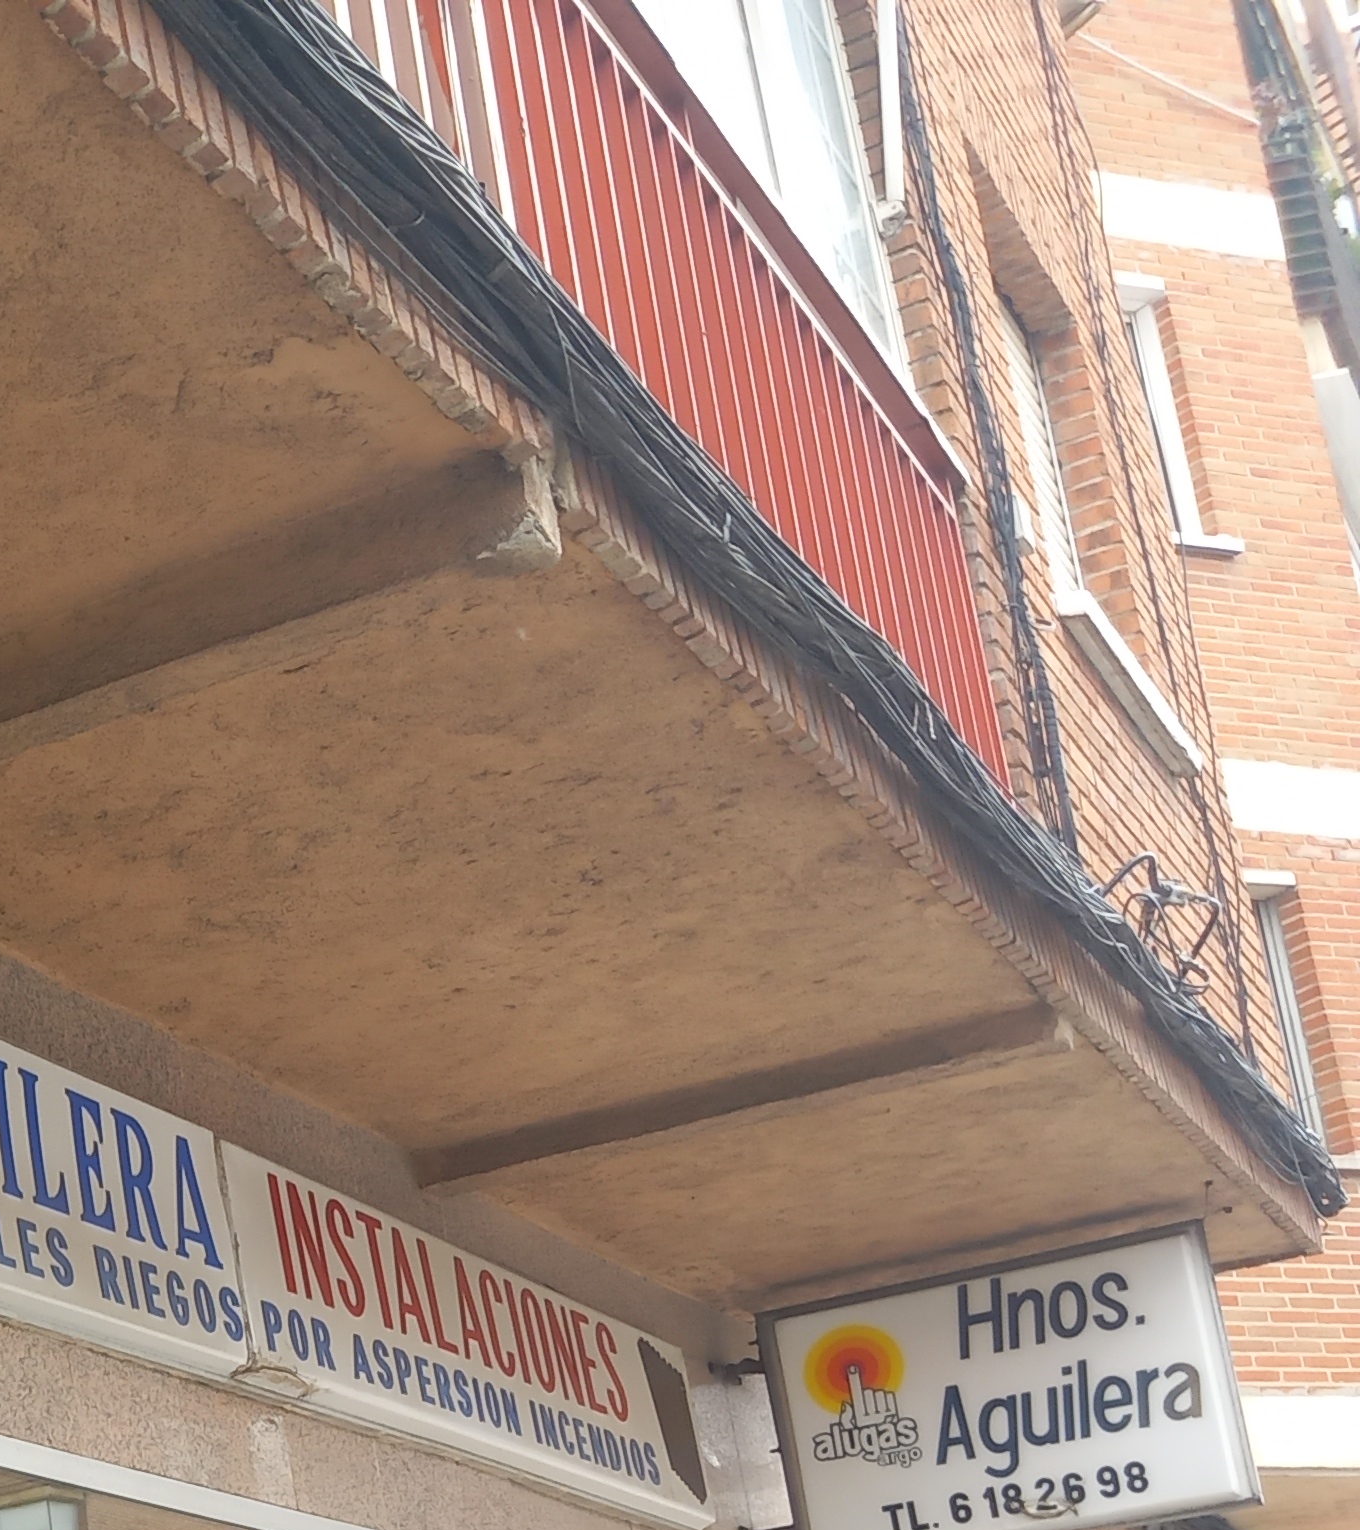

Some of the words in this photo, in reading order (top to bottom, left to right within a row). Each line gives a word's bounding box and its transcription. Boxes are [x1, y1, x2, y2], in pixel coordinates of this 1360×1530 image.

[93, 1244, 244, 1342] RIEGOS
[260, 1299, 337, 1371] POR
[352, 1332, 523, 1437] ASPERSION
[528, 1399, 661, 1486] INCENDIOS
[266, 1171, 630, 1423] INSTALACIONES
[956, 1271, 1147, 1361] Hnos.
[936, 1358, 1203, 1478] Aguilera
